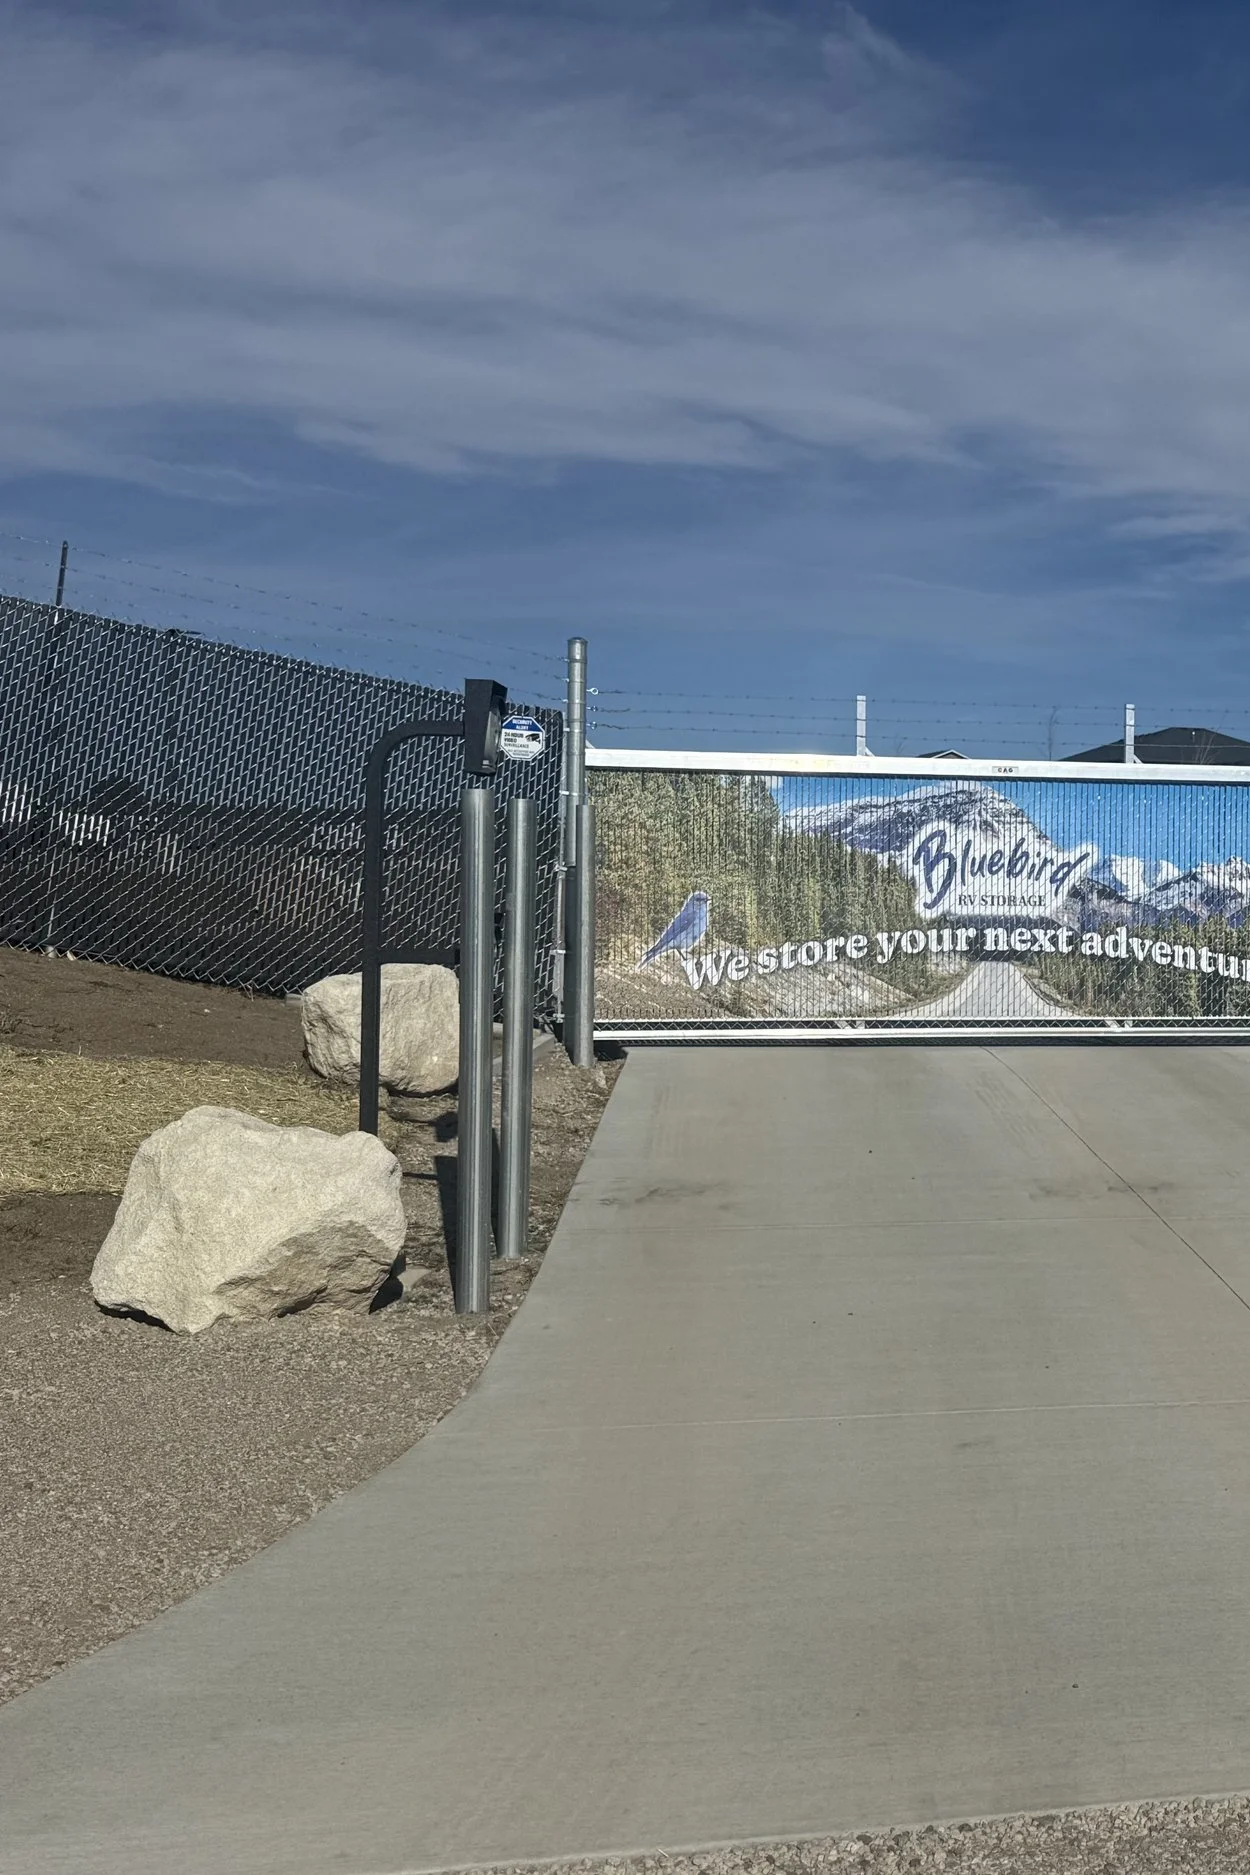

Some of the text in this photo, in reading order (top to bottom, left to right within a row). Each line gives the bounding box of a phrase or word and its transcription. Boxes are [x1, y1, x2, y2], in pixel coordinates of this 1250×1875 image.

[913, 829, 1091, 910] Bluebird
[958, 894, 1047, 907] RV STORAGE
[680, 947, 750, 991] We
[757, 932, 868, 975] store
[875, 926, 977, 964] your
[983, 926, 1074, 953] next
